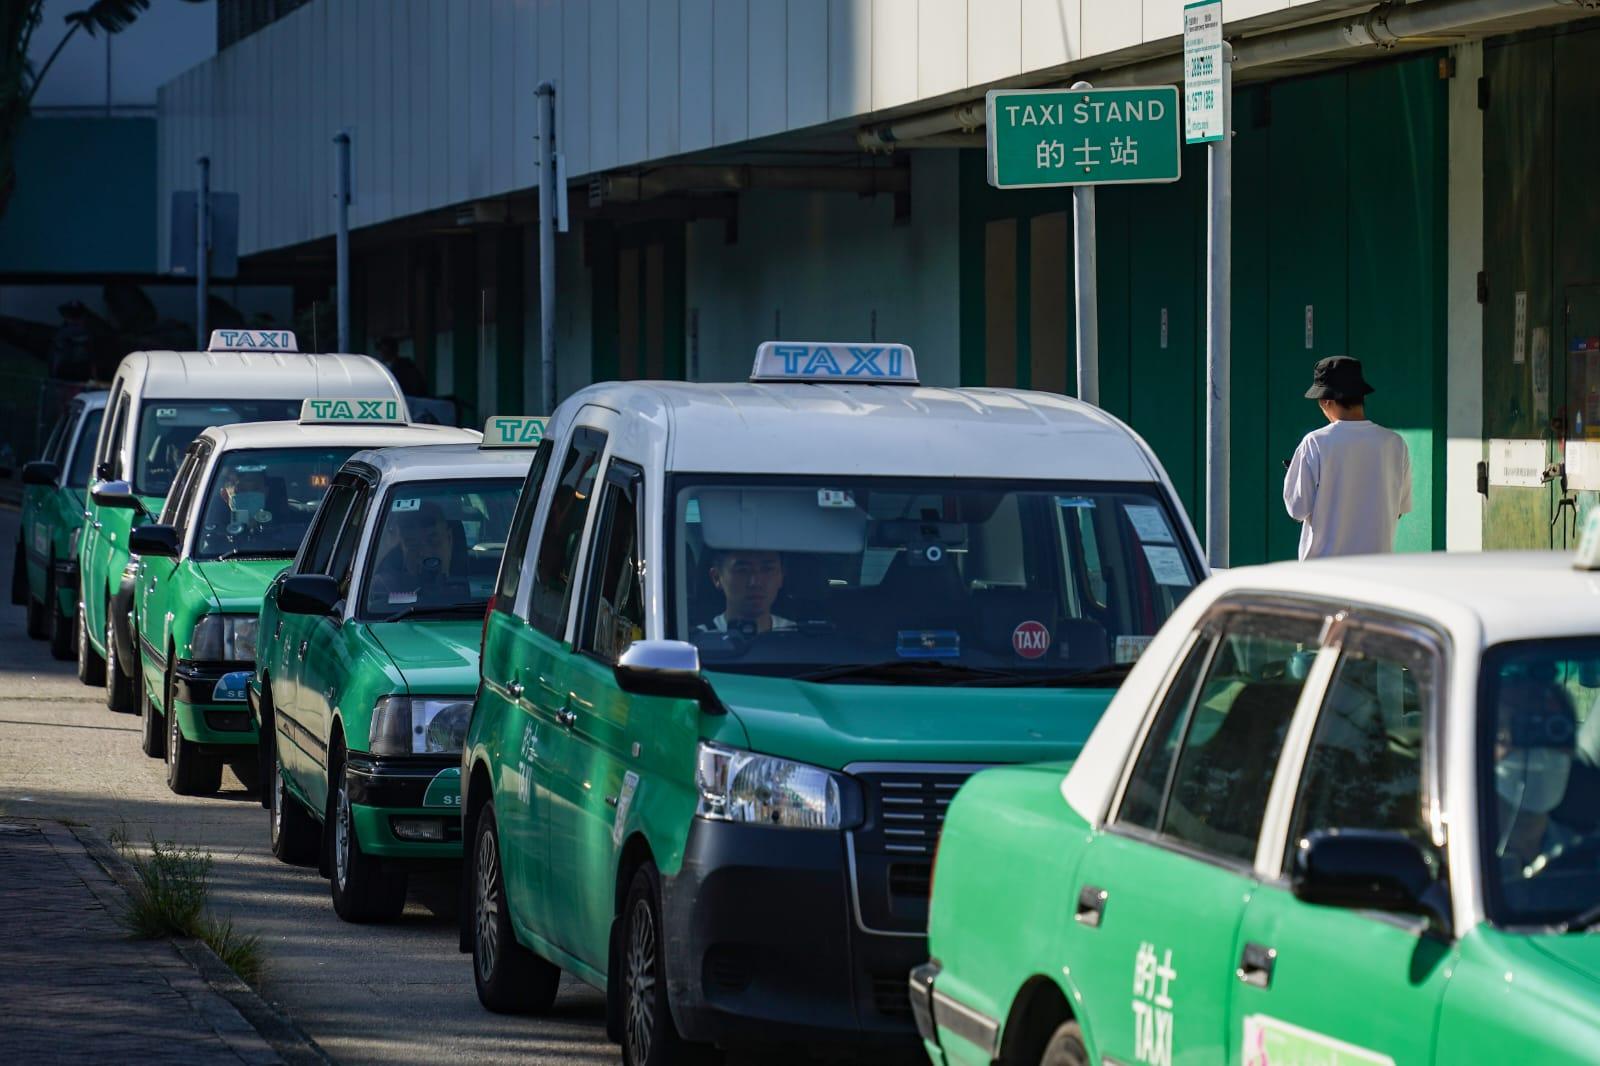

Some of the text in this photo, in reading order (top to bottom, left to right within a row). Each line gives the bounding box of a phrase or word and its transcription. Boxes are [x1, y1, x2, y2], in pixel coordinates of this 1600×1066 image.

[1005, 100, 1165, 127] TAXI STAND
[1036, 136, 1138, 169] 的士站
[220, 331, 289, 348] TAXI
[774, 345, 902, 376] TAXI
[310, 400, 397, 420] TAXI
[1016, 631, 1046, 650] TAXI
[1133, 941, 1177, 1009] 的士
[1131, 998, 1173, 1066] TAXI
